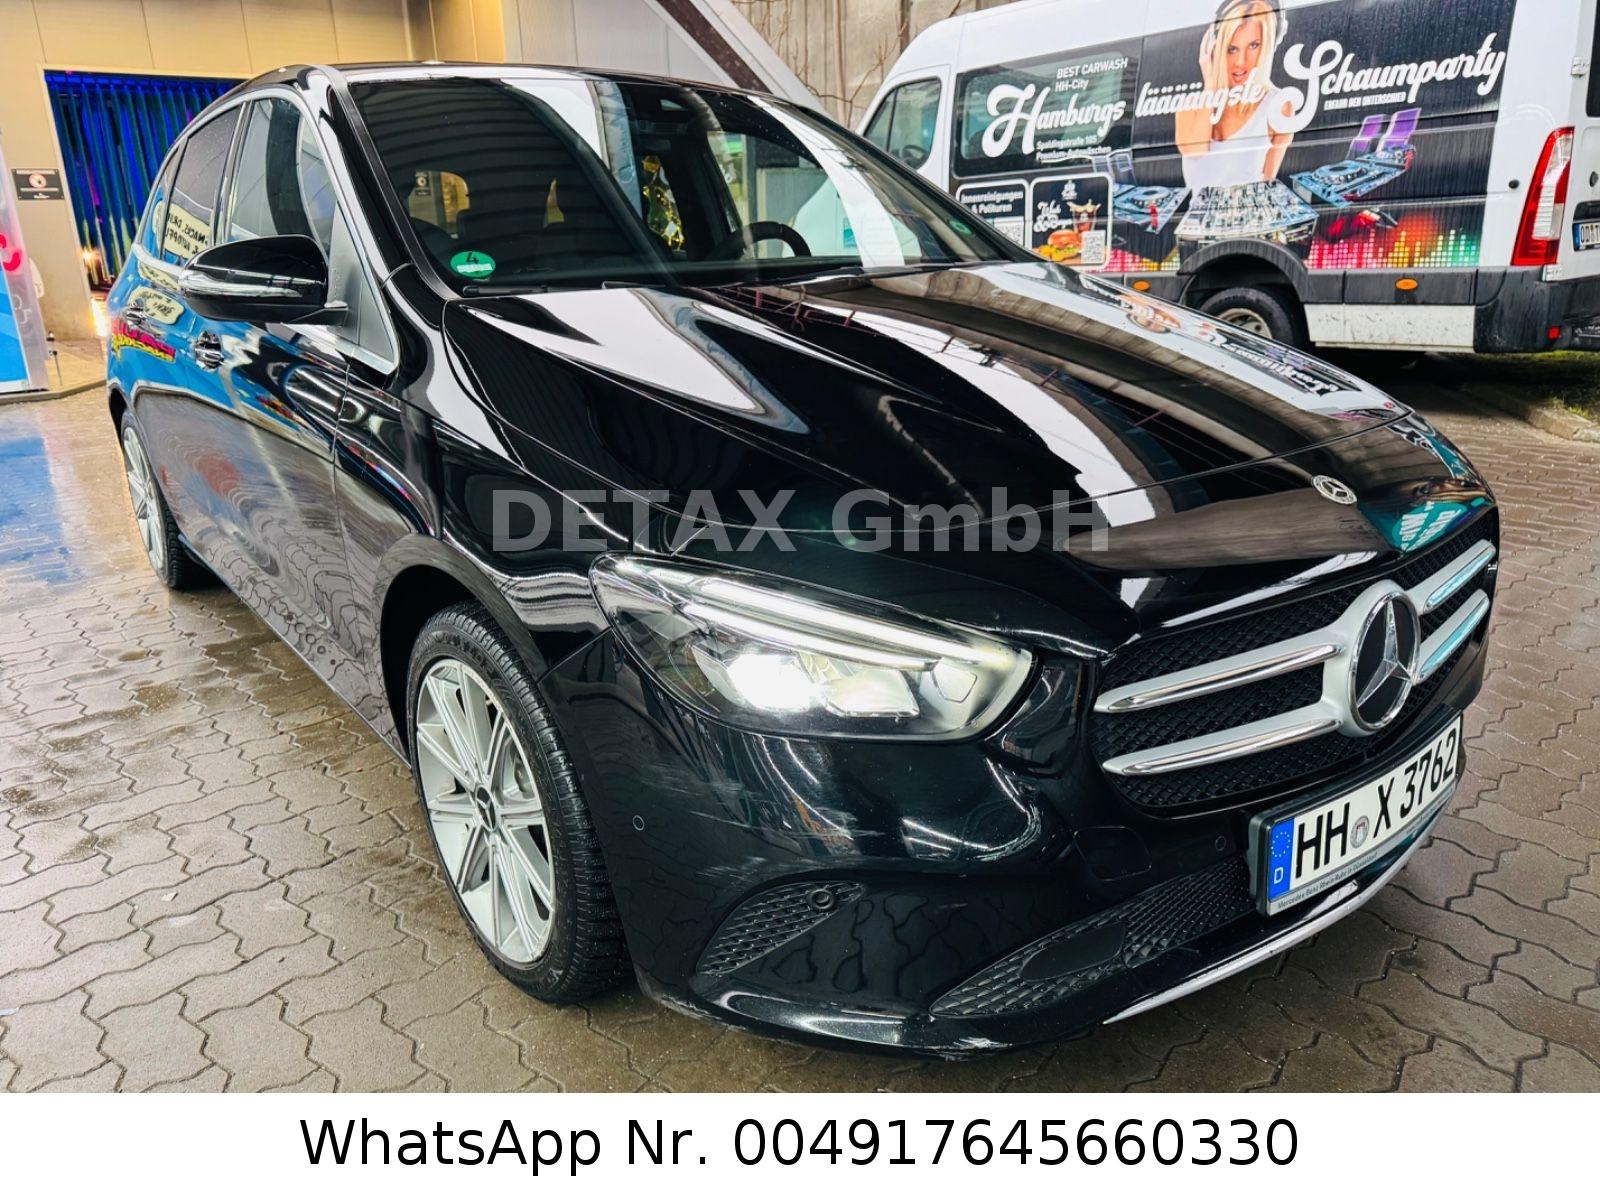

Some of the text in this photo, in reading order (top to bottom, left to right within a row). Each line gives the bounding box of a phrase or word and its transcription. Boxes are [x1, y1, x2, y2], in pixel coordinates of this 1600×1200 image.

[1054, 79, 1089, 92] HH-City
[1056, 57, 1128, 79] BEST CARWASH
[1267, 32, 1505, 134] Schaumparty
[981, 83, 1127, 159] Hamburgs
[1273, 866, 1284, 884] D
[1295, 802, 1350, 879] HH
[1373, 777, 1394, 838] X
[1400, 727, 1457, 819] 3762
